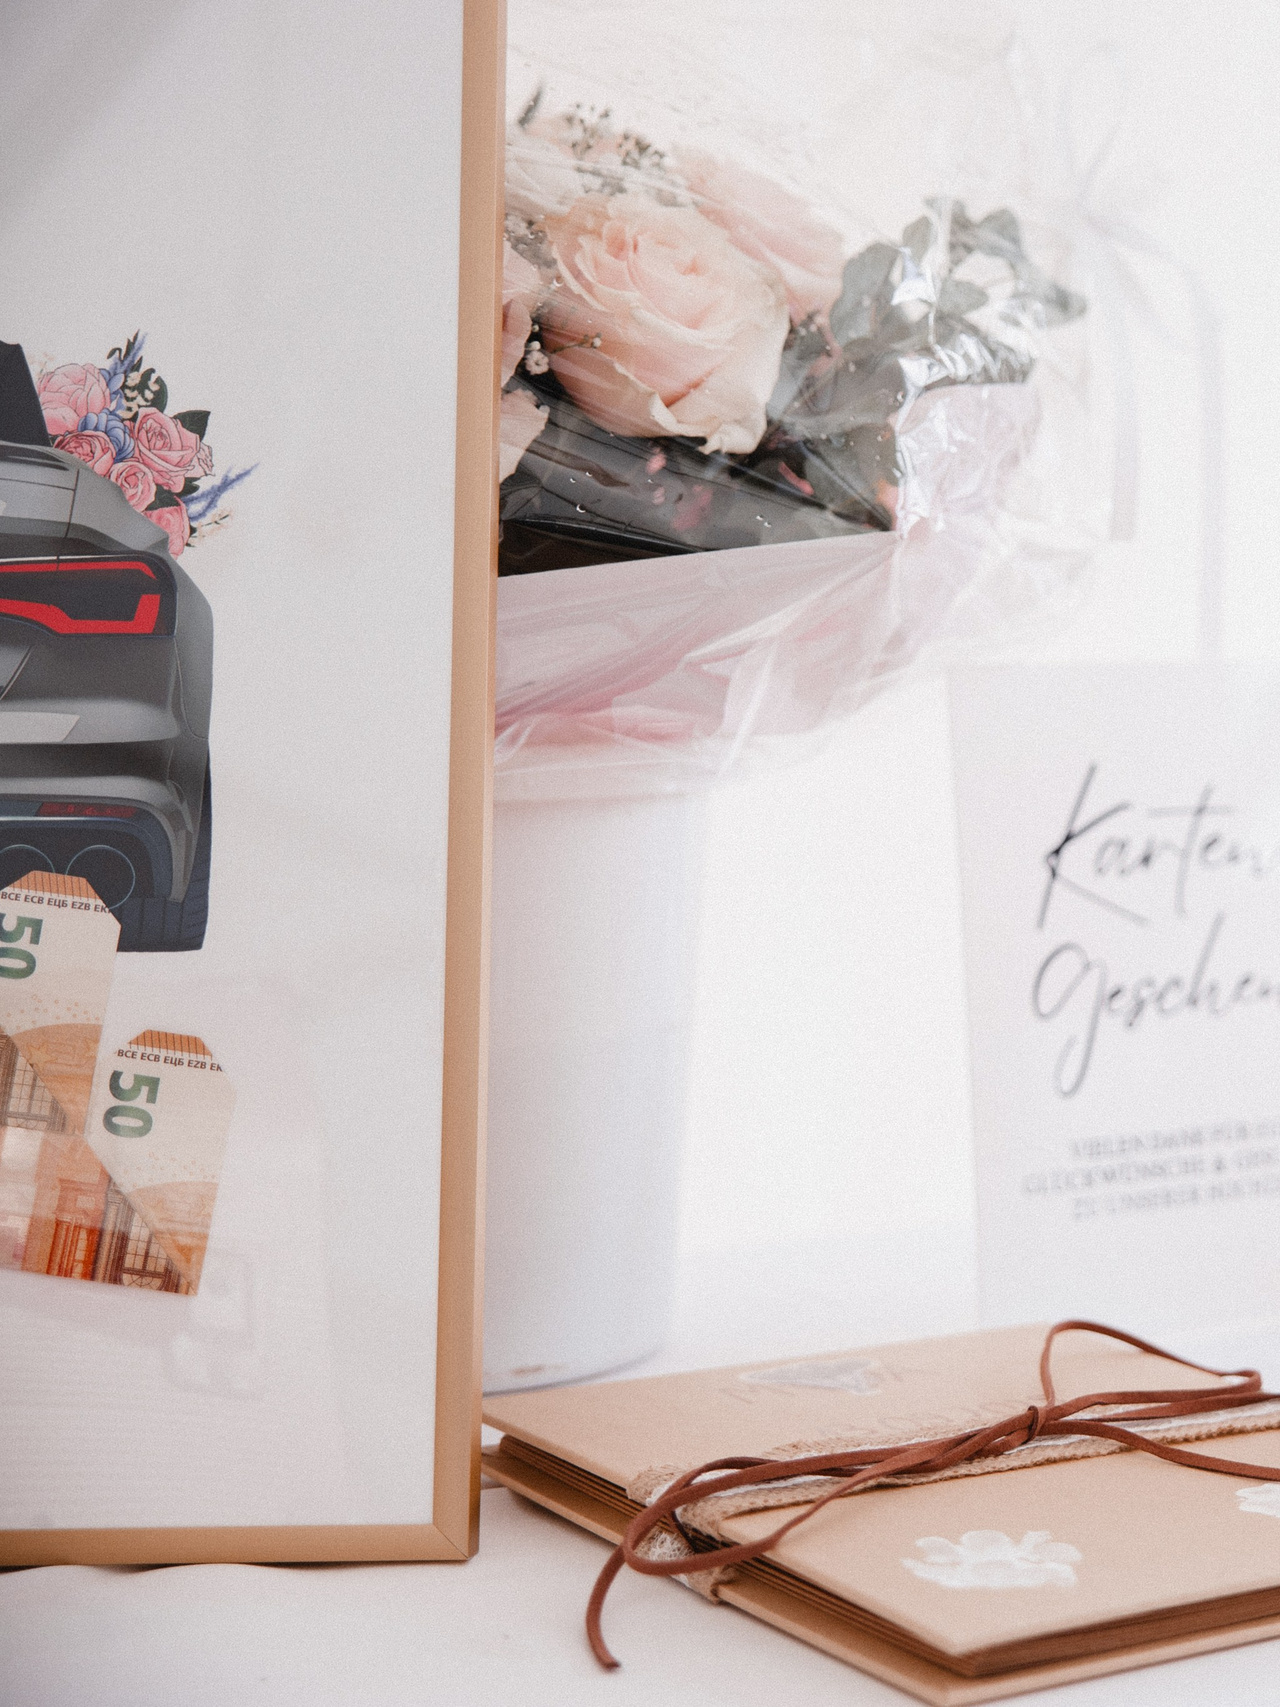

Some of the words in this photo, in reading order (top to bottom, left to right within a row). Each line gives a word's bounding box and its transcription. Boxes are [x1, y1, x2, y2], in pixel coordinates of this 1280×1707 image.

[0, 892, 21, 902] BCE
[24, 895, 44, 904] ECB
[71, 901, 91, 911] EZB
[0, 912, 44, 979] 50
[117, 1049, 138, 1060] BCE
[140, 1052, 161, 1063] ECB
[187, 1059, 207, 1070] EZB
[103, 1069, 160, 1138] 50
